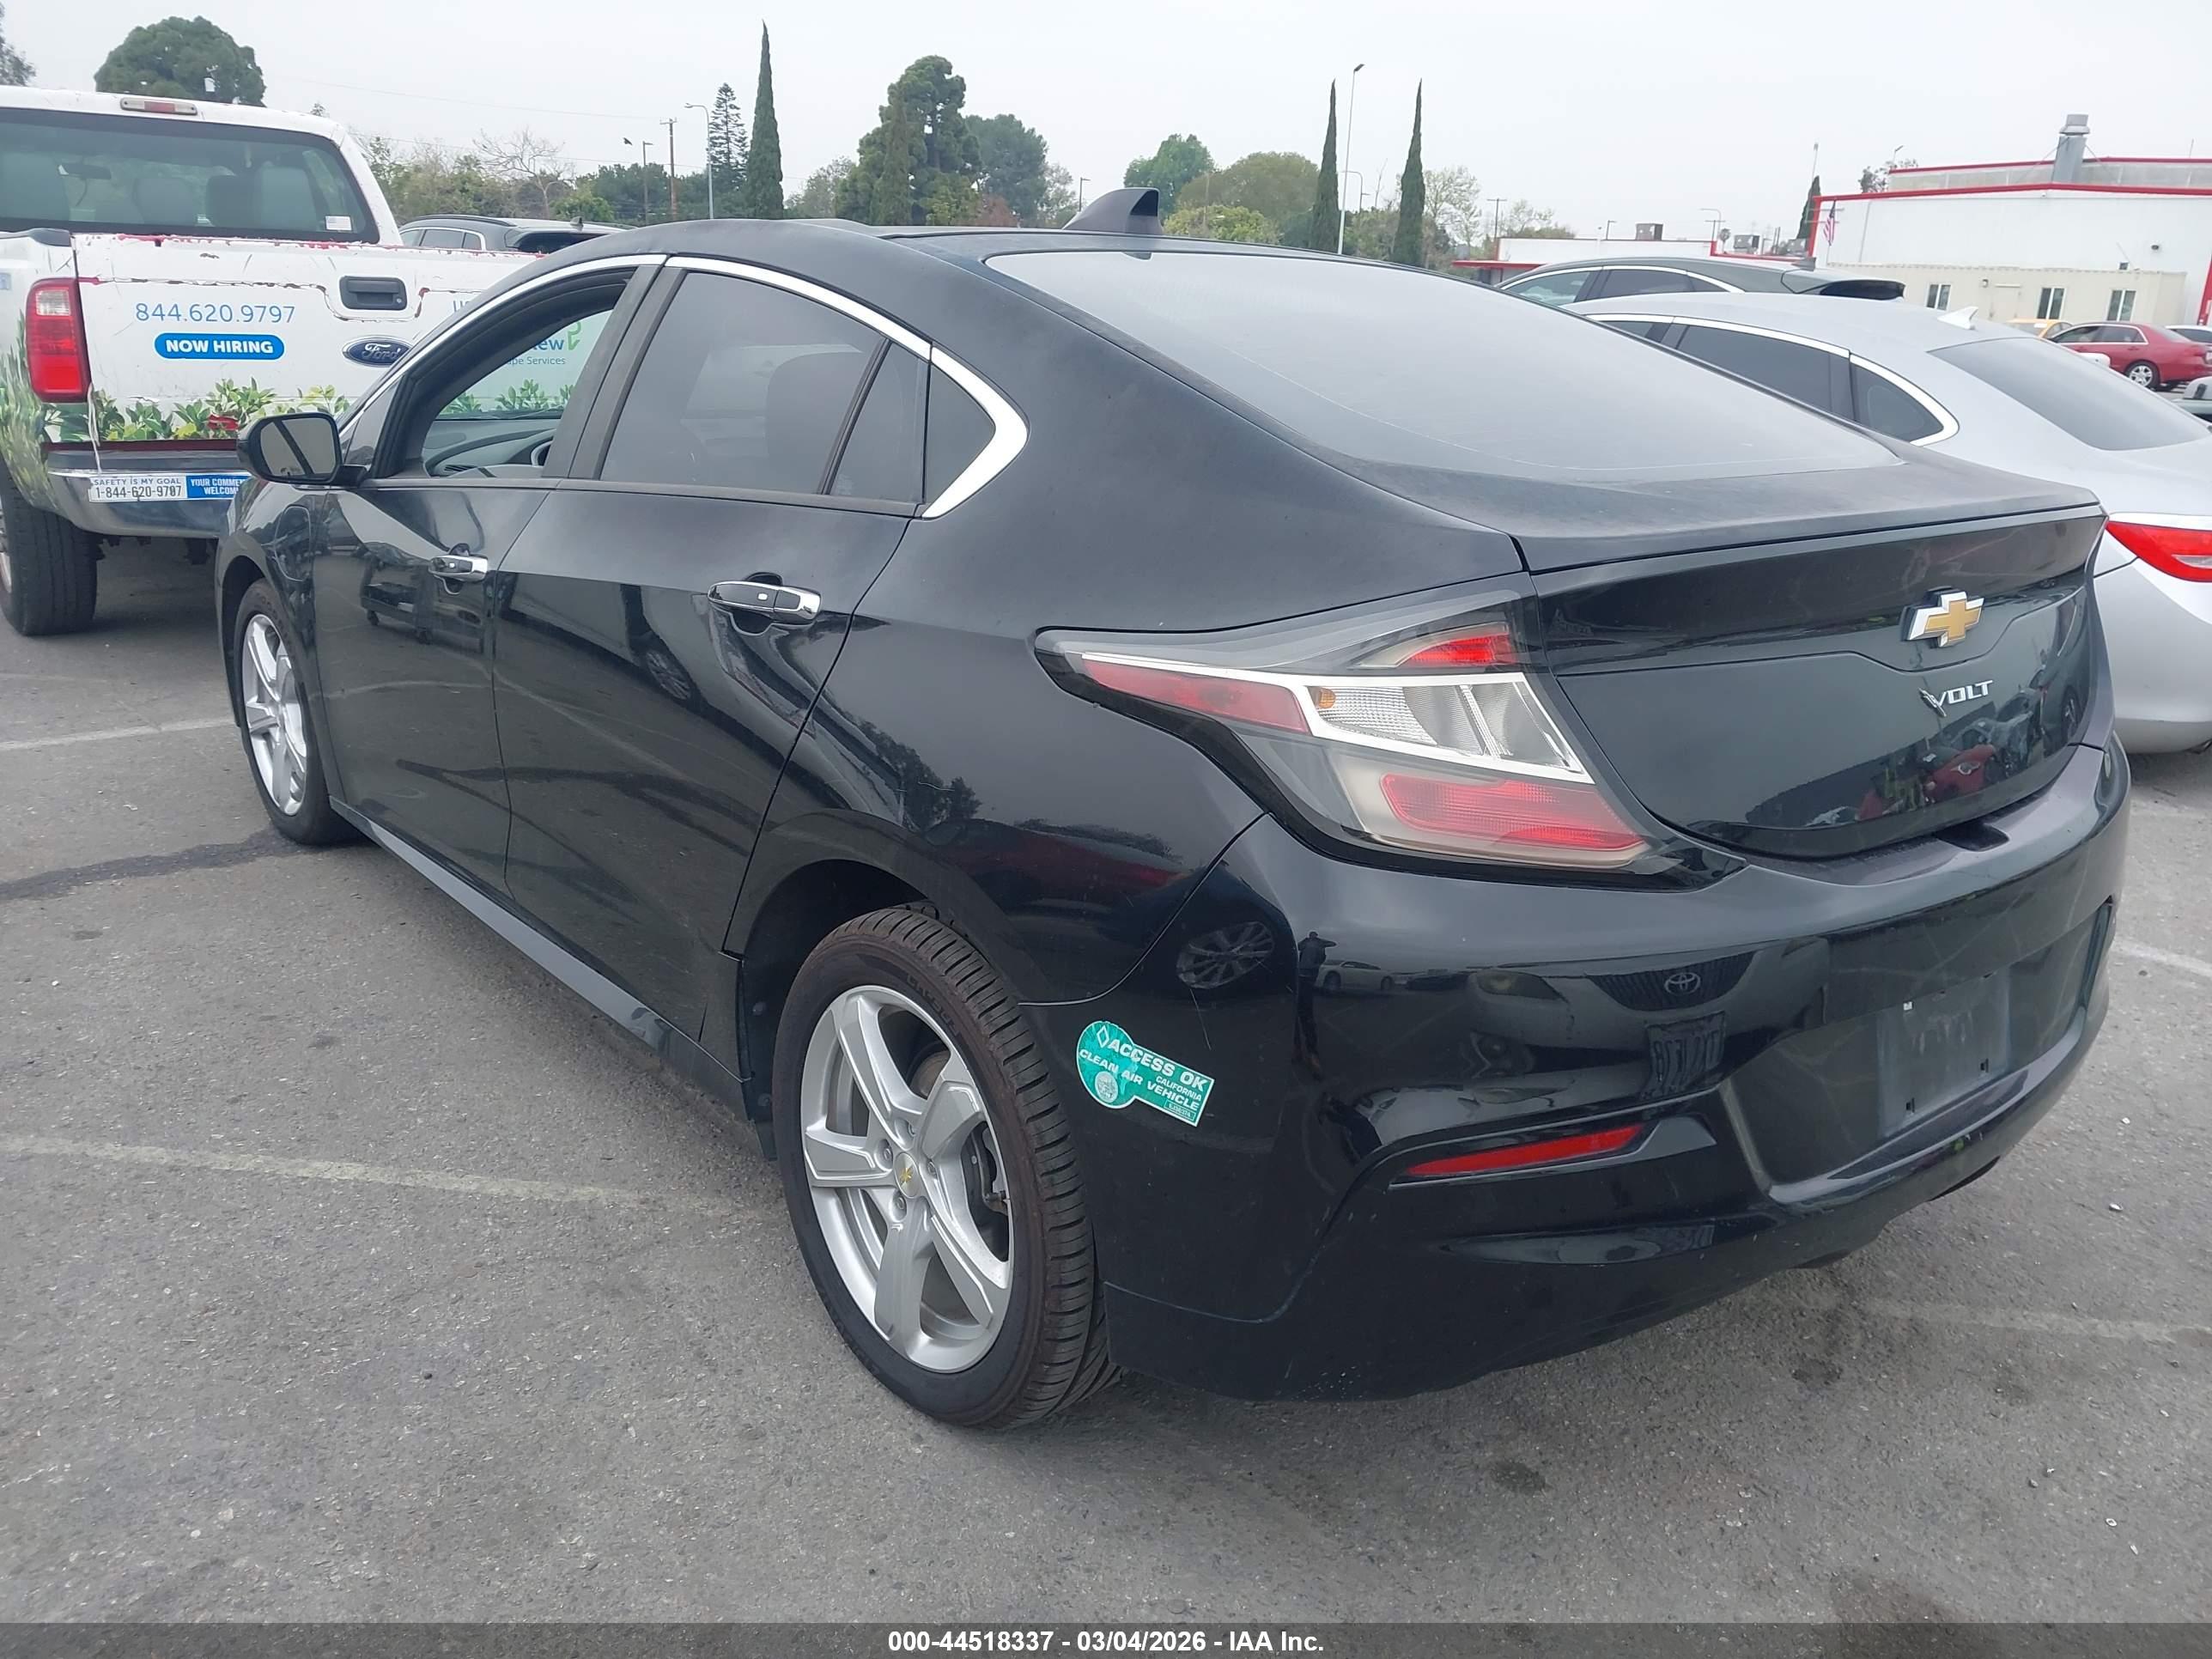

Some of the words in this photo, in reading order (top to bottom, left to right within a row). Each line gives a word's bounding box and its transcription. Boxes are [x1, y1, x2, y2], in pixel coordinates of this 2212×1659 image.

[135, 302, 295, 324] 844.620.9797
[165, 339, 209, 353] NOW
[214, 340, 274, 354] HIRING
[362, 343, 402, 360] Ford
[526, 356, 566, 365] Services
[190, 478, 210, 487] YOUR
[1918, 679, 1993, 717] VOLT
[1108, 1039, 1176, 1078] ACCESS
[1179, 1071, 1208, 1092] OK
[1079, 1048, 1119, 1073] CLEAN
[1121, 1070, 1144, 1085] AIR
[1146, 1080, 1200, 1111] VEHICLE
[1155, 1075, 1202, 1102] CALIFORNIA
